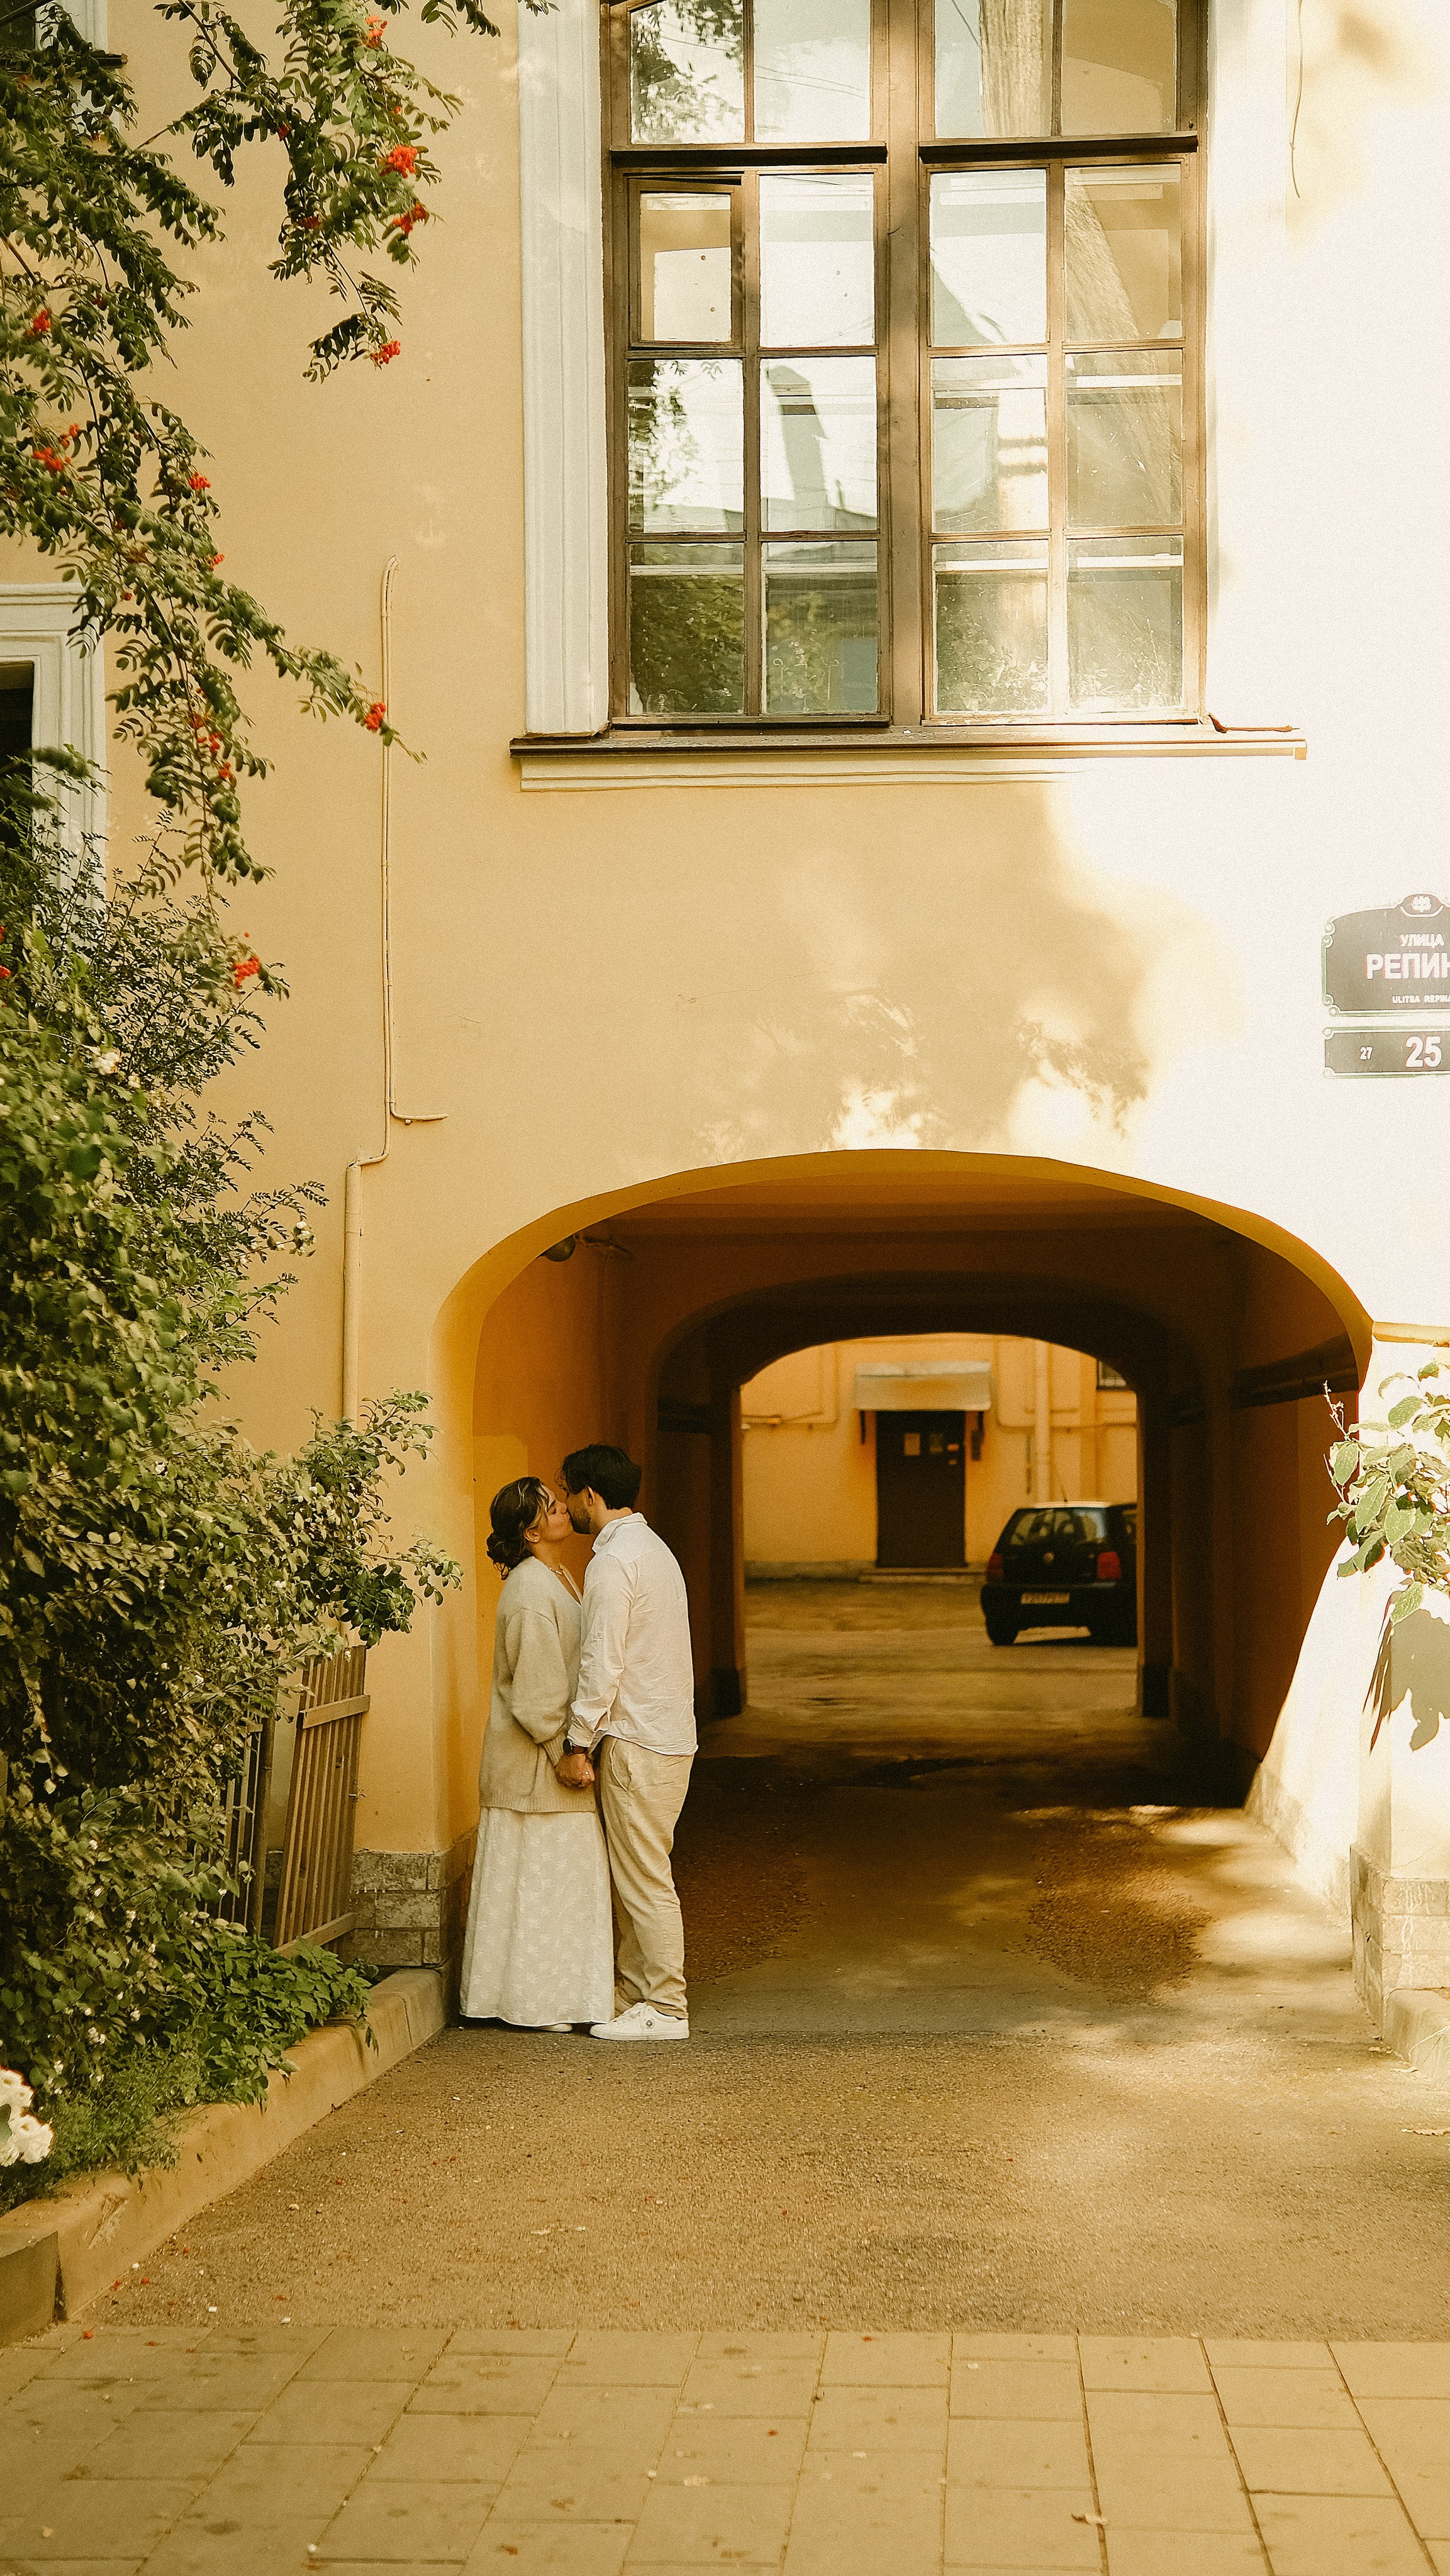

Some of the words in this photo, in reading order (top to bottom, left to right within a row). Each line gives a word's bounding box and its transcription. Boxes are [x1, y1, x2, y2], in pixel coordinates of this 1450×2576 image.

[1400, 933, 1445, 948] УЛИЦА
[1359, 1046, 1373, 1060] 27
[1405, 1036, 1442, 1068] 25
